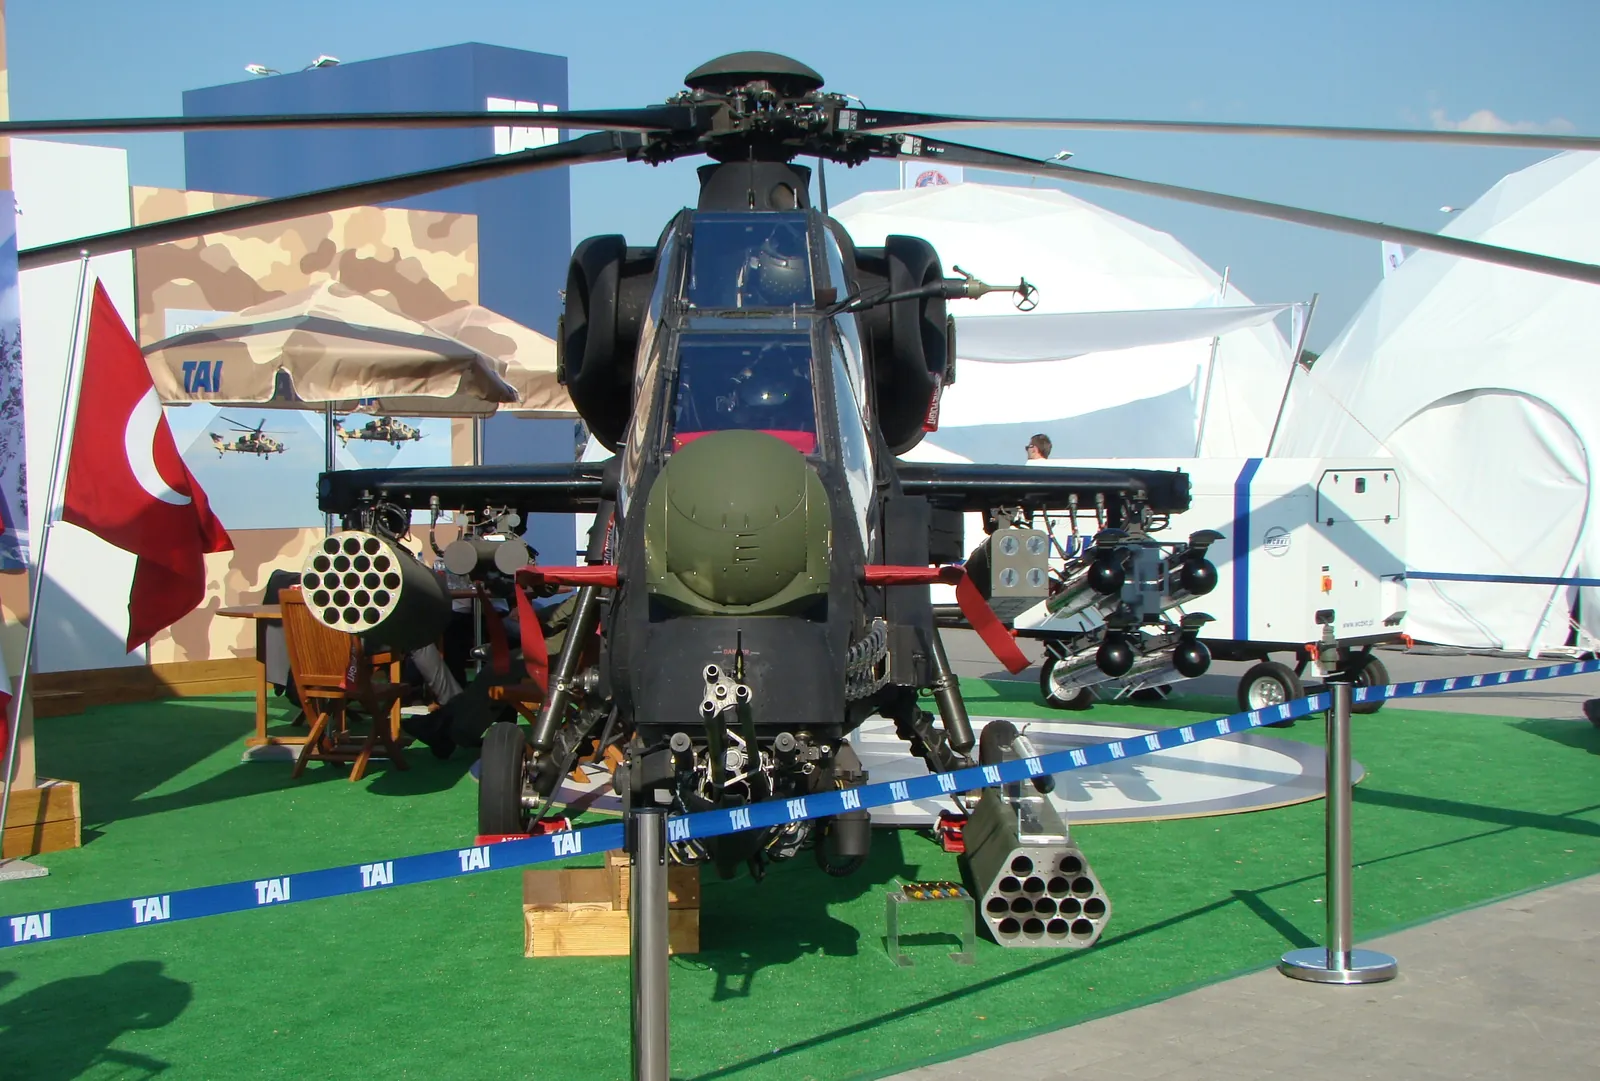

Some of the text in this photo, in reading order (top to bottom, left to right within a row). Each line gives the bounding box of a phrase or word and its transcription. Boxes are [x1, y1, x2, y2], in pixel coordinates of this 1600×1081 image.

[181, 360, 223, 393] TAI
[668, 694, 1319, 840] TAI TAI TAI TAI TAI TAI TAI TAI TAI TAI TAI TAI TAI TAI TAI TAI
[11, 831, 582, 942] TAI TAI TAI TAI TAI TAI
